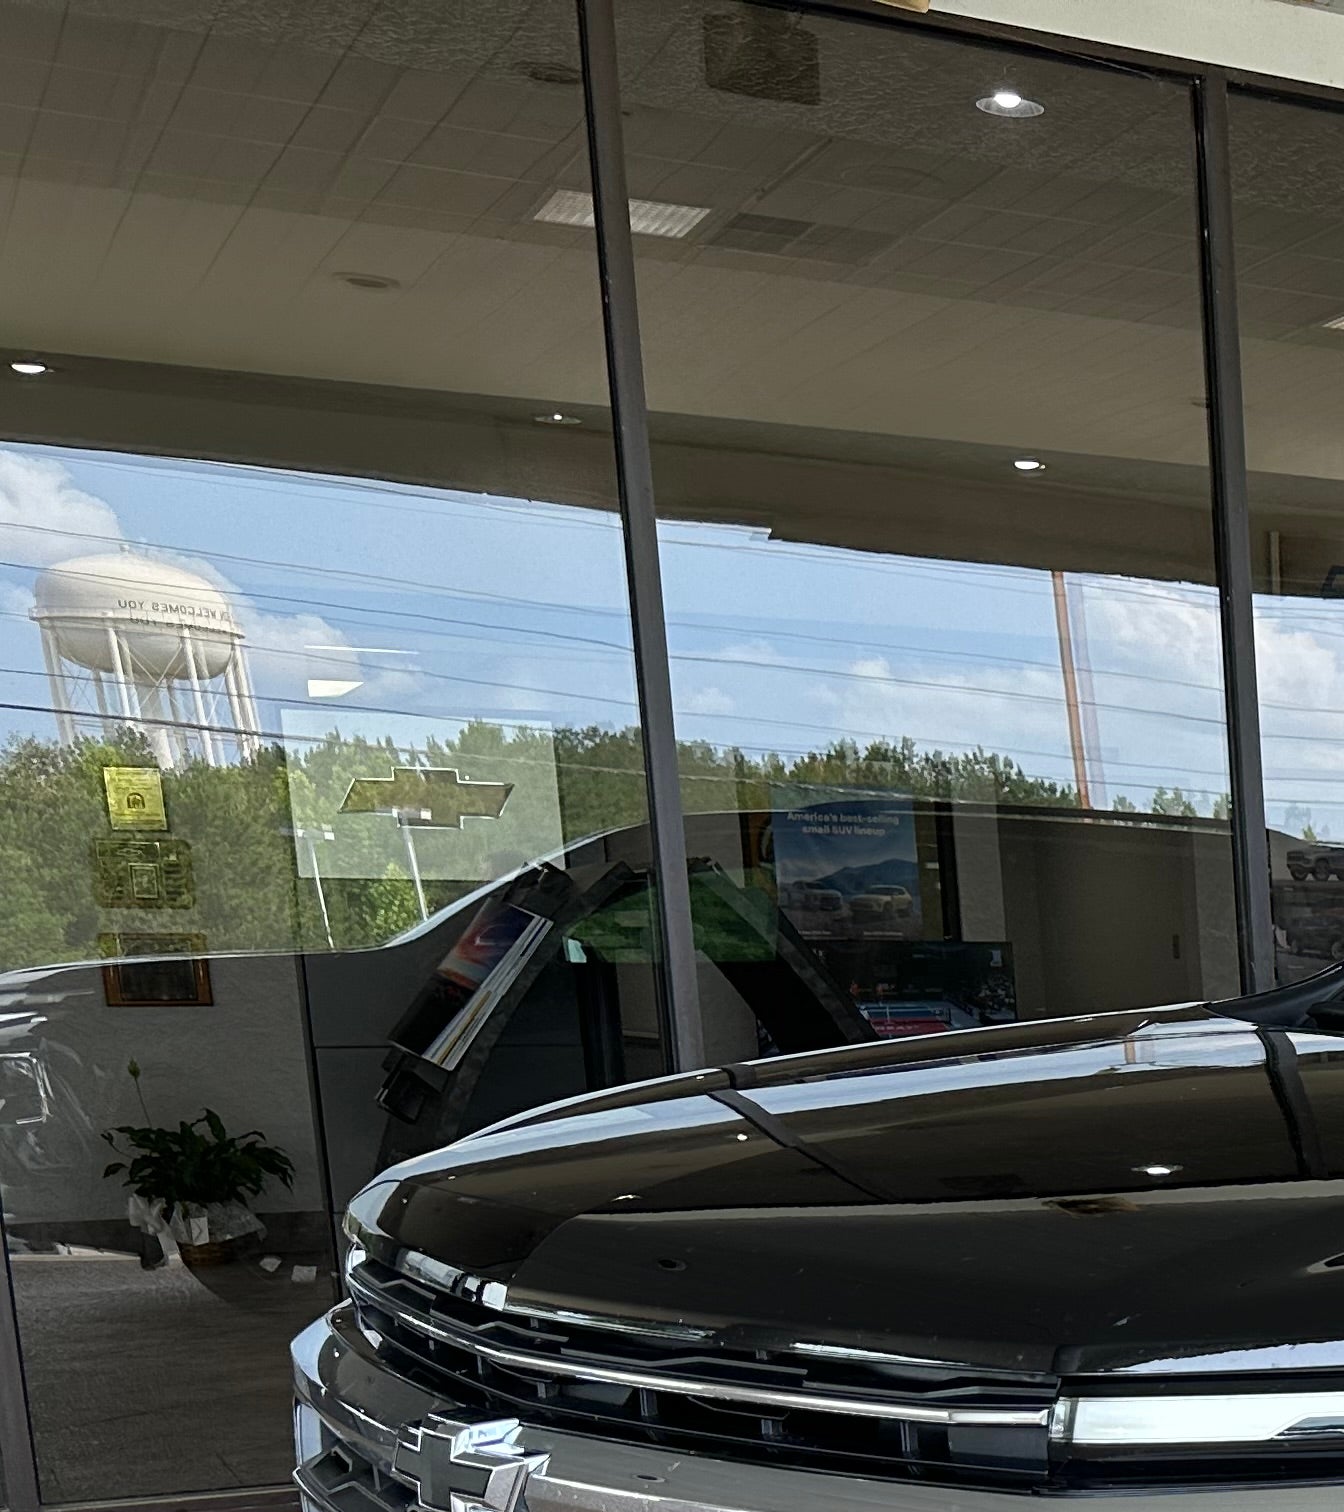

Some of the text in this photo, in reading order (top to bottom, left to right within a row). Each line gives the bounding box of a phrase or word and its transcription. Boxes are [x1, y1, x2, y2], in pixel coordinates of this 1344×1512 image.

[786, 811, 900, 826] America's best-selling
[801, 825, 886, 837] small SUV lineup
